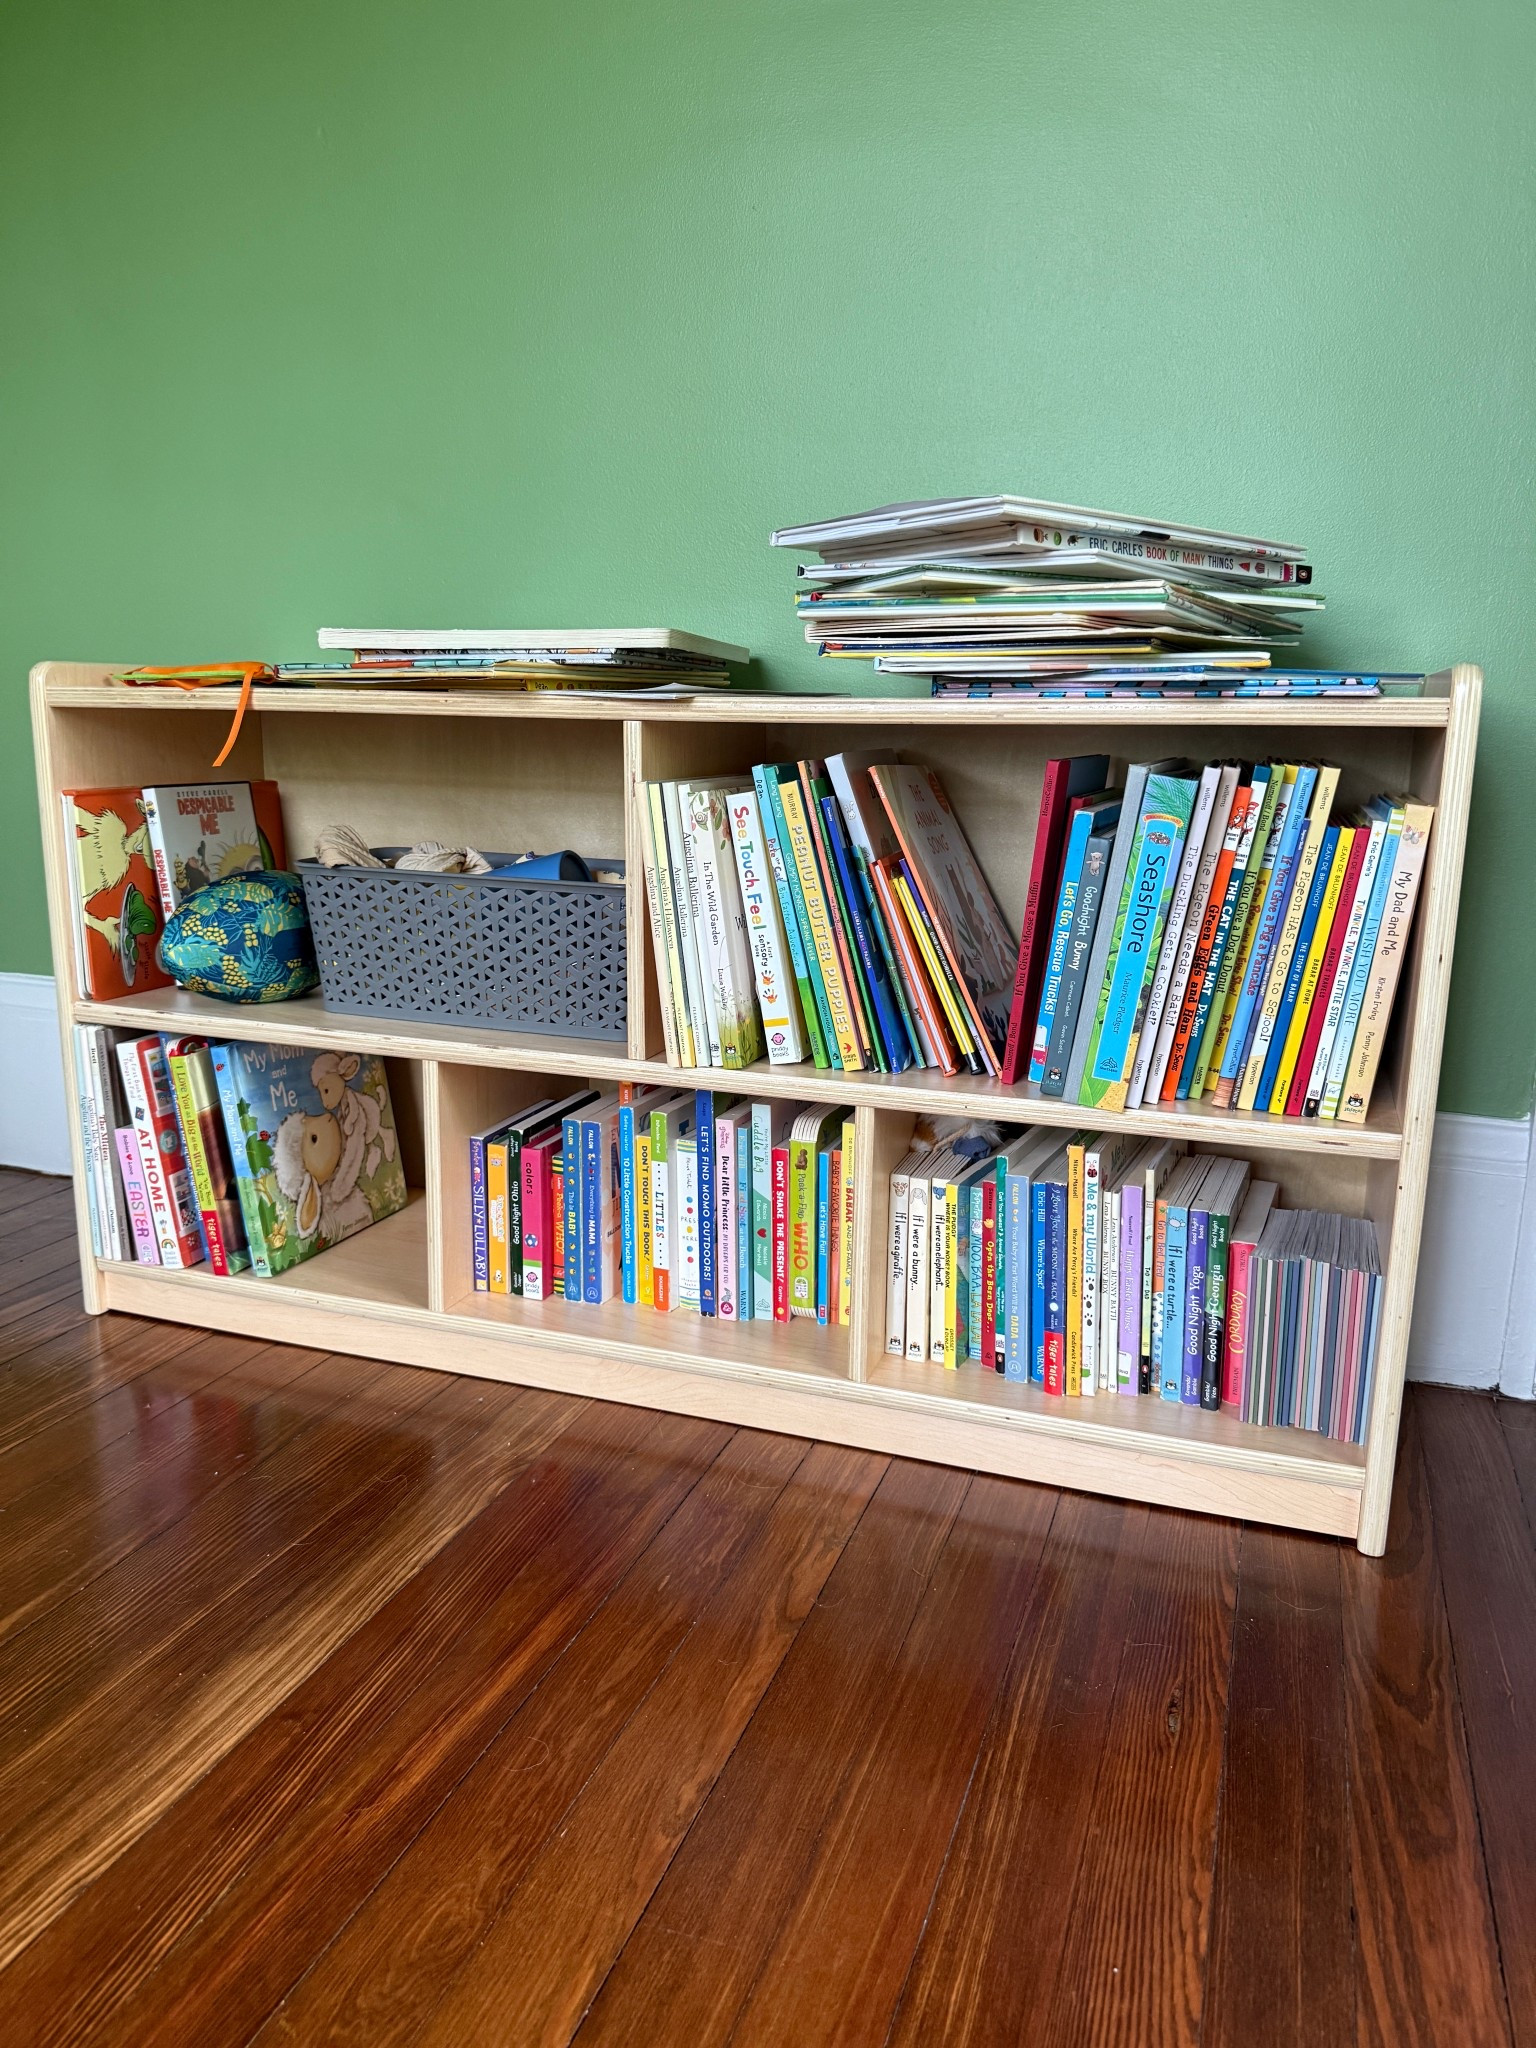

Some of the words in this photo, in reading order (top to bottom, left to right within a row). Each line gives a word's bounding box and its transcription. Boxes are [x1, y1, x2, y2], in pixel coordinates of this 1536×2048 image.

[1089, 537, 1108, 550] ERIC
[1111, 541, 1143, 556] CARLE'S
[1146, 546, 1170, 560] BOOK
[1169, 549, 1180, 562] OF
[1182, 551, 1205, 565] MANY
[1207, 555, 1233, 570] THINGS
[177, 790, 199, 798] STEVE
[756, 780, 764, 799] Dean
[1201, 788, 1210, 810] willems
[178, 794, 234, 815] DESPICABLE
[787, 793, 798, 818] MURRAY
[199, 813, 220, 835] ME
[703, 861, 711, 871] In
[740, 841, 759, 890] Touch,
[766, 838, 777, 857] Pete
[772, 864, 786, 883] Cat
[1186, 846, 1199, 867] The
[1202, 853, 1217, 876] The
[1339, 845, 1348, 862] JEAN
[152, 850, 169, 897] DESPICABLE
[162, 901, 173, 913] ME
[682, 832, 694, 873] Angelina
[688, 877, 700, 917] Ballerina
[705, 872, 713, 890] The
[1245, 869, 1257, 879] If
[1336, 864, 1343, 873] DE
[1395, 871, 1412, 888] My
[707, 891, 717, 912] Wild
[1063, 881, 1078, 907] Let's
[1167, 872, 1191, 926] Duckling
[1226, 880, 1239, 901] THE
[1240, 878, 1255, 899] You
[1328, 875, 1340, 910] BRUNHOFF
[747, 893, 766, 929] Feel
[1077, 886, 1097, 935] Goodnight
[1128, 855, 1165, 952] Seashore
[1186, 881, 1209, 927] Pigeon
[1233, 900, 1249, 923] Give
[1393, 892, 1408, 913] Dad
[710, 914, 719, 945] Garden
[792, 827, 816, 891] PEANUT
[809, 899, 831, 962] BUTTER
[825, 969, 848, 1034] PUPPIES
[1058, 909, 1073, 927] Go,
[1202, 905, 1219, 940] Green
[1218, 906, 1232, 929] CAT
[1349, 900, 1365, 936] TWINKLE,
[1387, 917, 1399, 936] and
[757, 934, 768, 966] sensory
[1163, 932, 1177, 958] Gets
[1214, 930, 1224, 944] IN
[1224, 932, 1240, 953] Dog
[1361, 927, 1376, 958] WISH
[1381, 940, 1397, 955] Me
[1052, 931, 1069, 971] Rescue
[1068, 941, 1087, 970] Bunny
[1178, 933, 1196, 974] Needs
[1190, 945, 1209, 976] Eggs
[1208, 947, 1221, 967] THE
[1339, 941, 1356, 977] TWINKLE,
[1215, 963, 1232, 994] Donut
[1310, 959, 1319, 978] BABAR
[1355, 963, 1368, 987] YOU
[1045, 976, 1061, 1015] Trucks!
[1120, 972, 1132, 1004] Maurice
[1188, 982, 1198, 1003] and
[1201, 970, 1215, 995] HAT
[1333, 980, 1345, 1004] LITTLE
[1147, 977, 1166, 1025] Cookie!?
[1303, 989, 1311, 1004] HOME
[1345, 992, 1361, 1023] MORE
[1113, 1006, 1125, 1034] Pledger
[1166, 994, 1181, 1026] Bath!
[1180, 1008, 1193, 1034] Ham
[1327, 1006, 1339, 1027] STAR
[1175, 1043, 1184, 1053] Dr.
[243, 1050, 266, 1075] My
[271, 1065, 287, 1079] and
[1133, 1058, 1144, 1084] hyperion
[1171, 1054, 1182, 1071] Seuss
[177, 1072, 187, 1092] Love
[181, 1094, 190, 1109] You
[270, 1082, 297, 1111] Me
[98, 1114, 106, 1131] The
[186, 1120, 195, 1135] Big
[99, 1131, 110, 1160] Mitten
[701, 1126, 709, 1152] LET'S
[138, 1129, 152, 1149] AT
[145, 1158, 165, 1212] HOME
[193, 1152, 205, 1176] World
[623, 1158, 630, 1166] 10
[776, 1161, 785, 1187] DON'T
[526, 1162, 534, 1194] colors
[1087, 1182, 1097, 1200] Me
[128, 1182, 149, 1237] EASTER
[472, 1186, 484, 1218] SILLY
[702, 1184, 710, 1217] MOMO
[797, 1174, 807, 1219] Peek-a-Flap
[512, 1203, 521, 1224] Night
[568, 1212, 576, 1235] BABY
[655, 1192, 664, 1238] LITTLES
[1082, 1213, 1094, 1234] my
[207, 1218, 217, 1241] tiger
[212, 1244, 222, 1266] tales
[473, 1224, 486, 1277] LULLABY
[703, 1221, 711, 1280] OUTDOORS!
[794, 1223, 808, 1270] WHO
[986, 1241, 995, 1261] Open
[891, 1251, 903, 1284] giraffe...
[1086, 1238, 1096, 1273] World
[1036, 1269, 1044, 1289] Spot?
[1189, 1266, 1204, 1290] Yoga
[1208, 1264, 1223, 1307] Georgia
[1188, 1295, 1201, 1325] Night
[1209, 1309, 1221, 1336] Night
[1228, 1289, 1245, 1354] CORDUROY
[1187, 1328, 1198, 1355] Good
[1207, 1338, 1217, 1362] Good
